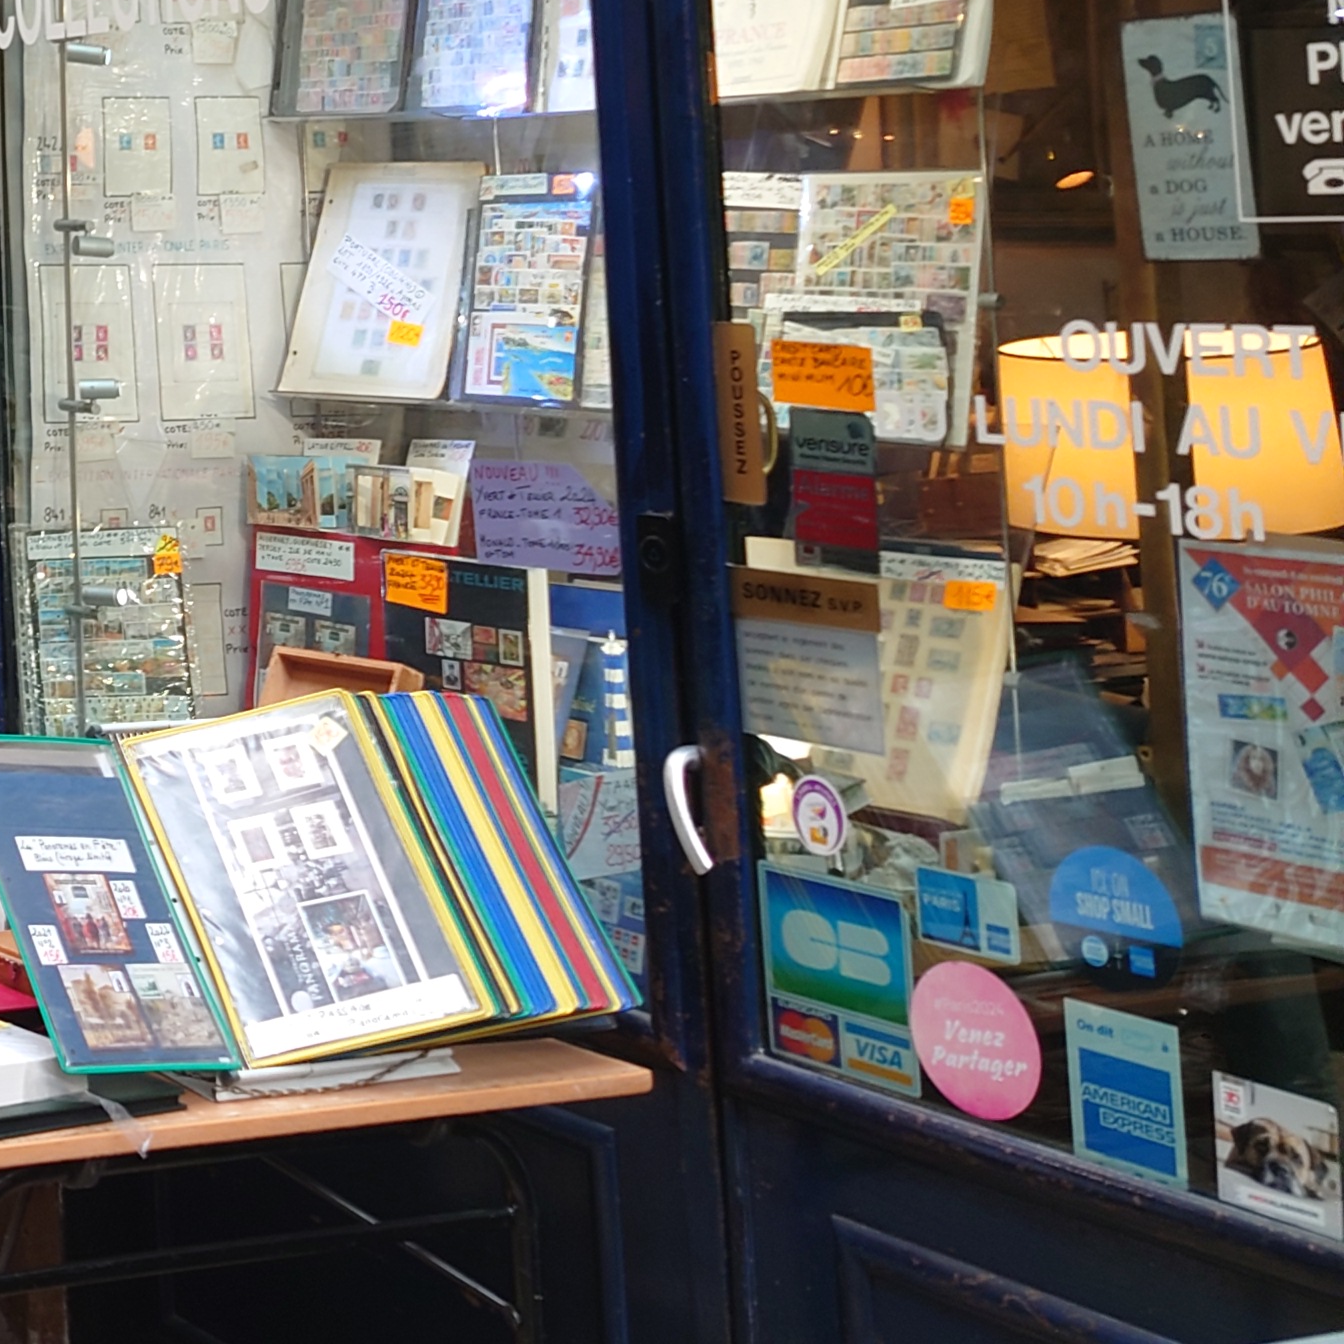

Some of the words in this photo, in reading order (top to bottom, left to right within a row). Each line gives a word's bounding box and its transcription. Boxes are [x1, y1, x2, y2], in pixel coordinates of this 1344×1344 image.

[1160, 131, 1214, 147] HOME
[1165, 179, 1208, 195] DOG
[1060, 319, 1315, 381] OUVERT
[729, 349, 748, 475] POUSSEZ
[973, 393, 1145, 455] LUNDI
[1177, 404, 1261, 459] AU
[452, 570, 524, 592] TELLIER
[742, 581, 822, 609] SONNEZ
[1244, 582, 1296, 599] SALON
[1075, 891, 1110, 920] SHOP
[1112, 899, 1155, 929] SMALL
[943, 1019, 1006, 1048] Venez
[1076, 1018, 1094, 1034] On
[1096, 1024, 1114, 1037] dit
[855, 1040, 903, 1070] VISA
[931, 1045, 1028, 1082] Partager
[1081, 1084, 1168, 1122] AMERICAN
[1102, 1111, 1176, 1145] EXPRESS
